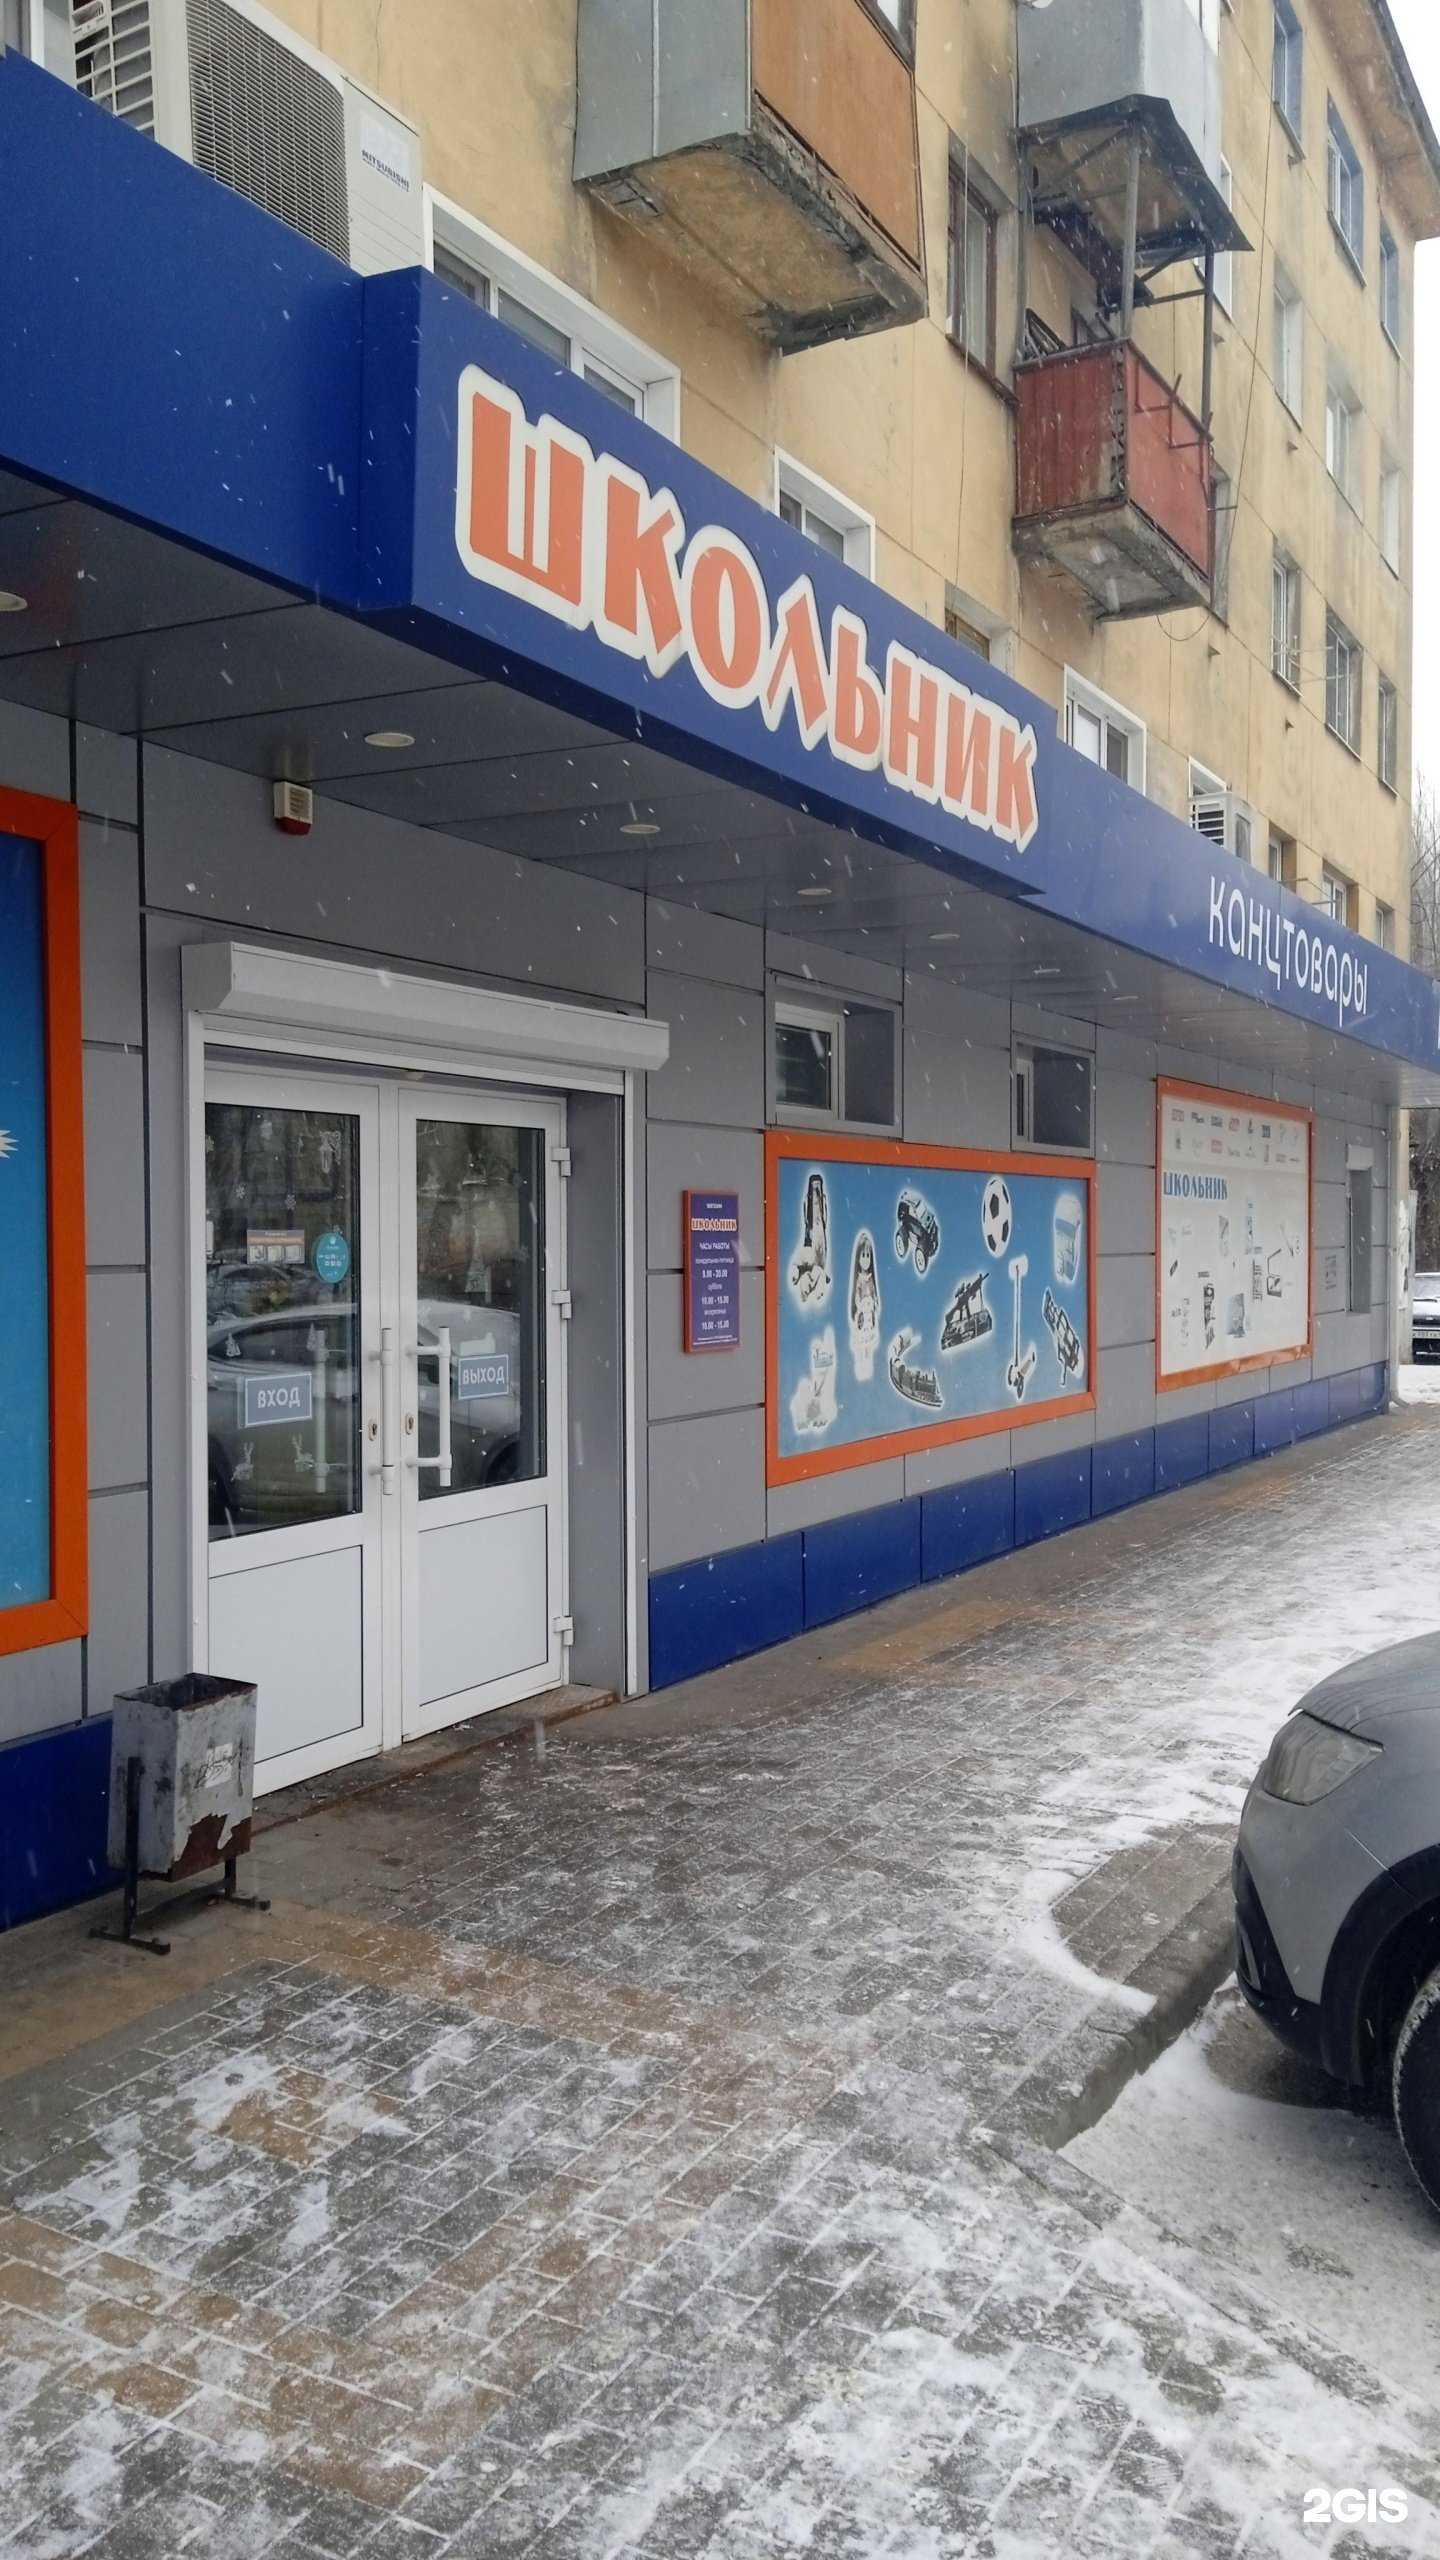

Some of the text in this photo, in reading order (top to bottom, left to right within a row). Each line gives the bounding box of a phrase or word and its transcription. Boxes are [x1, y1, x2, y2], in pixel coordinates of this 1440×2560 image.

[361, 150, 409, 188] MITSUBISHI
[457, 364, 1039, 852] ШКОЛЬНИК
[1163, 1171, 1228, 1201] ШКОЛЬНИК
[691, 1217, 738, 1232] ШКОЛЬНИК
[462, 1365, 505, 1385] ВЫХОД
[257, 1386, 301, 1409] ВХОД
